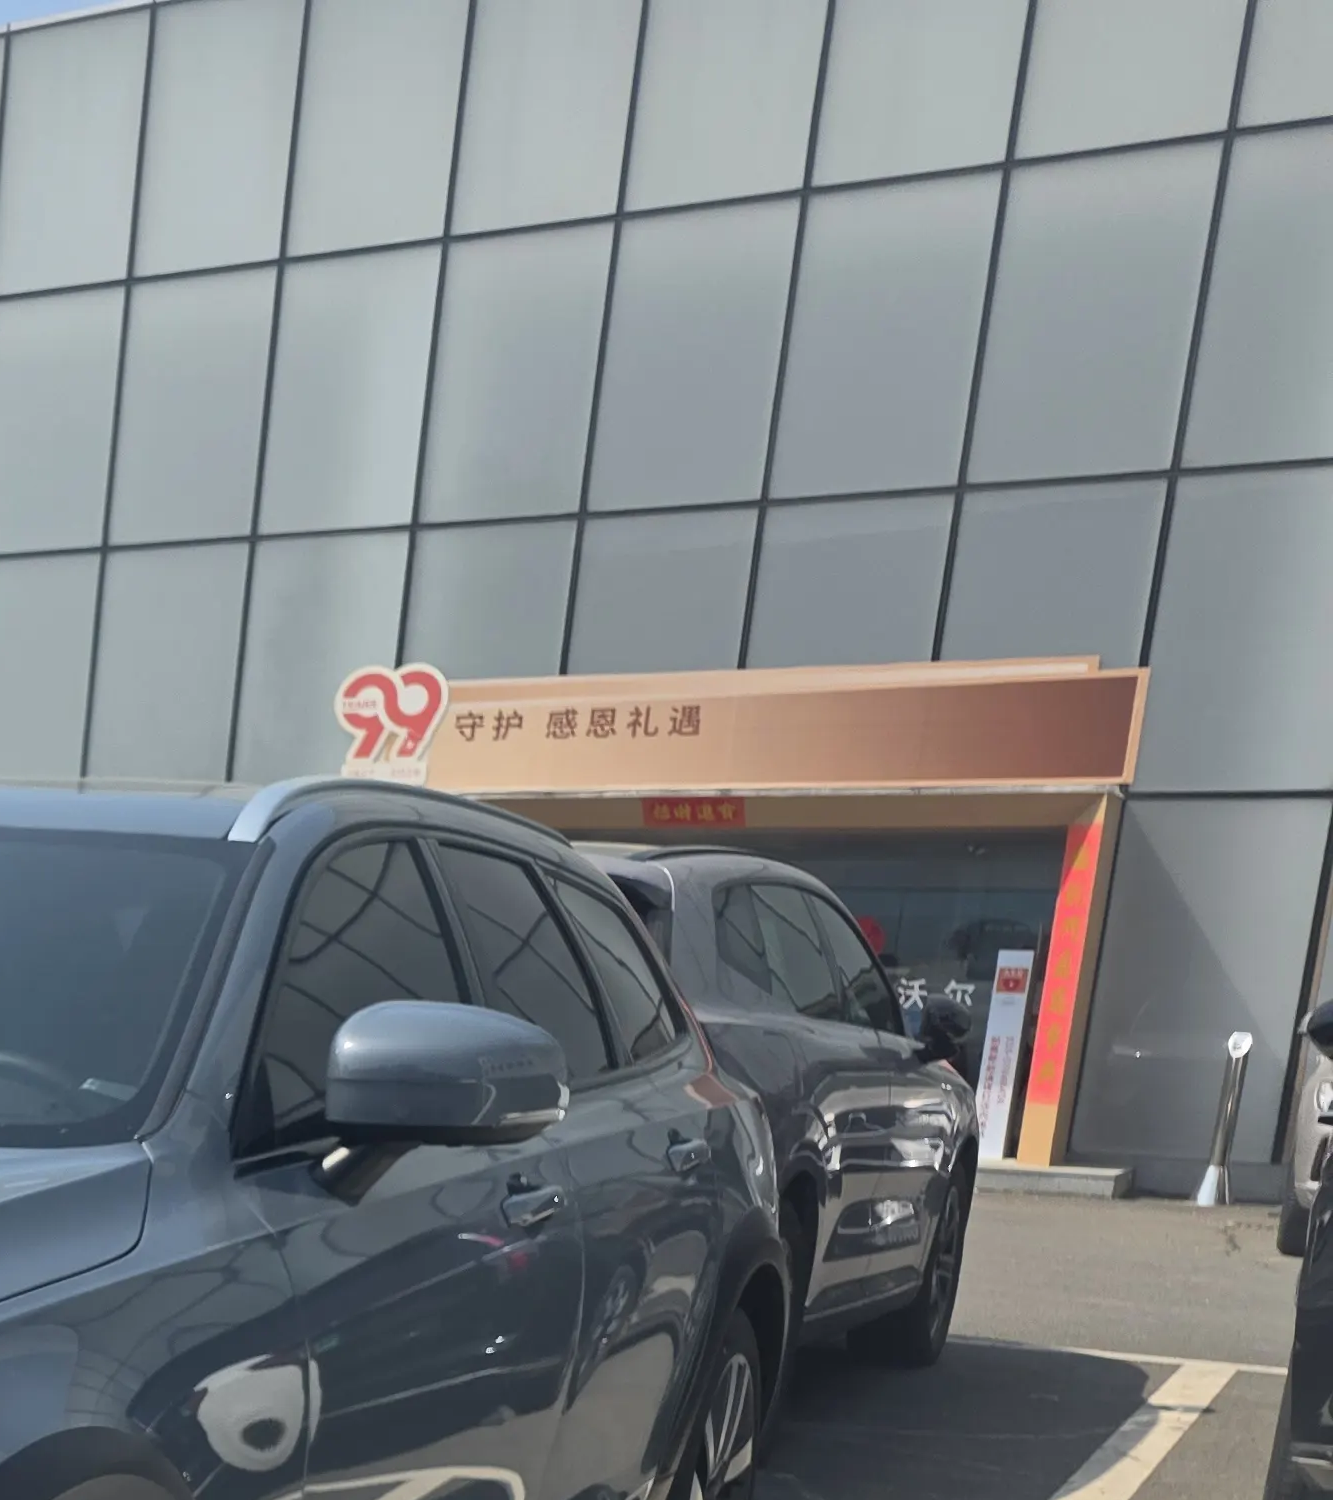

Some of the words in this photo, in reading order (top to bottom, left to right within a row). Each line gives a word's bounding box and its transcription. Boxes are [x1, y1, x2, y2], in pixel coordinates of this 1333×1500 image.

[455, 710, 523, 741] 守护
[545, 705, 701, 740] 感恩礼遇
